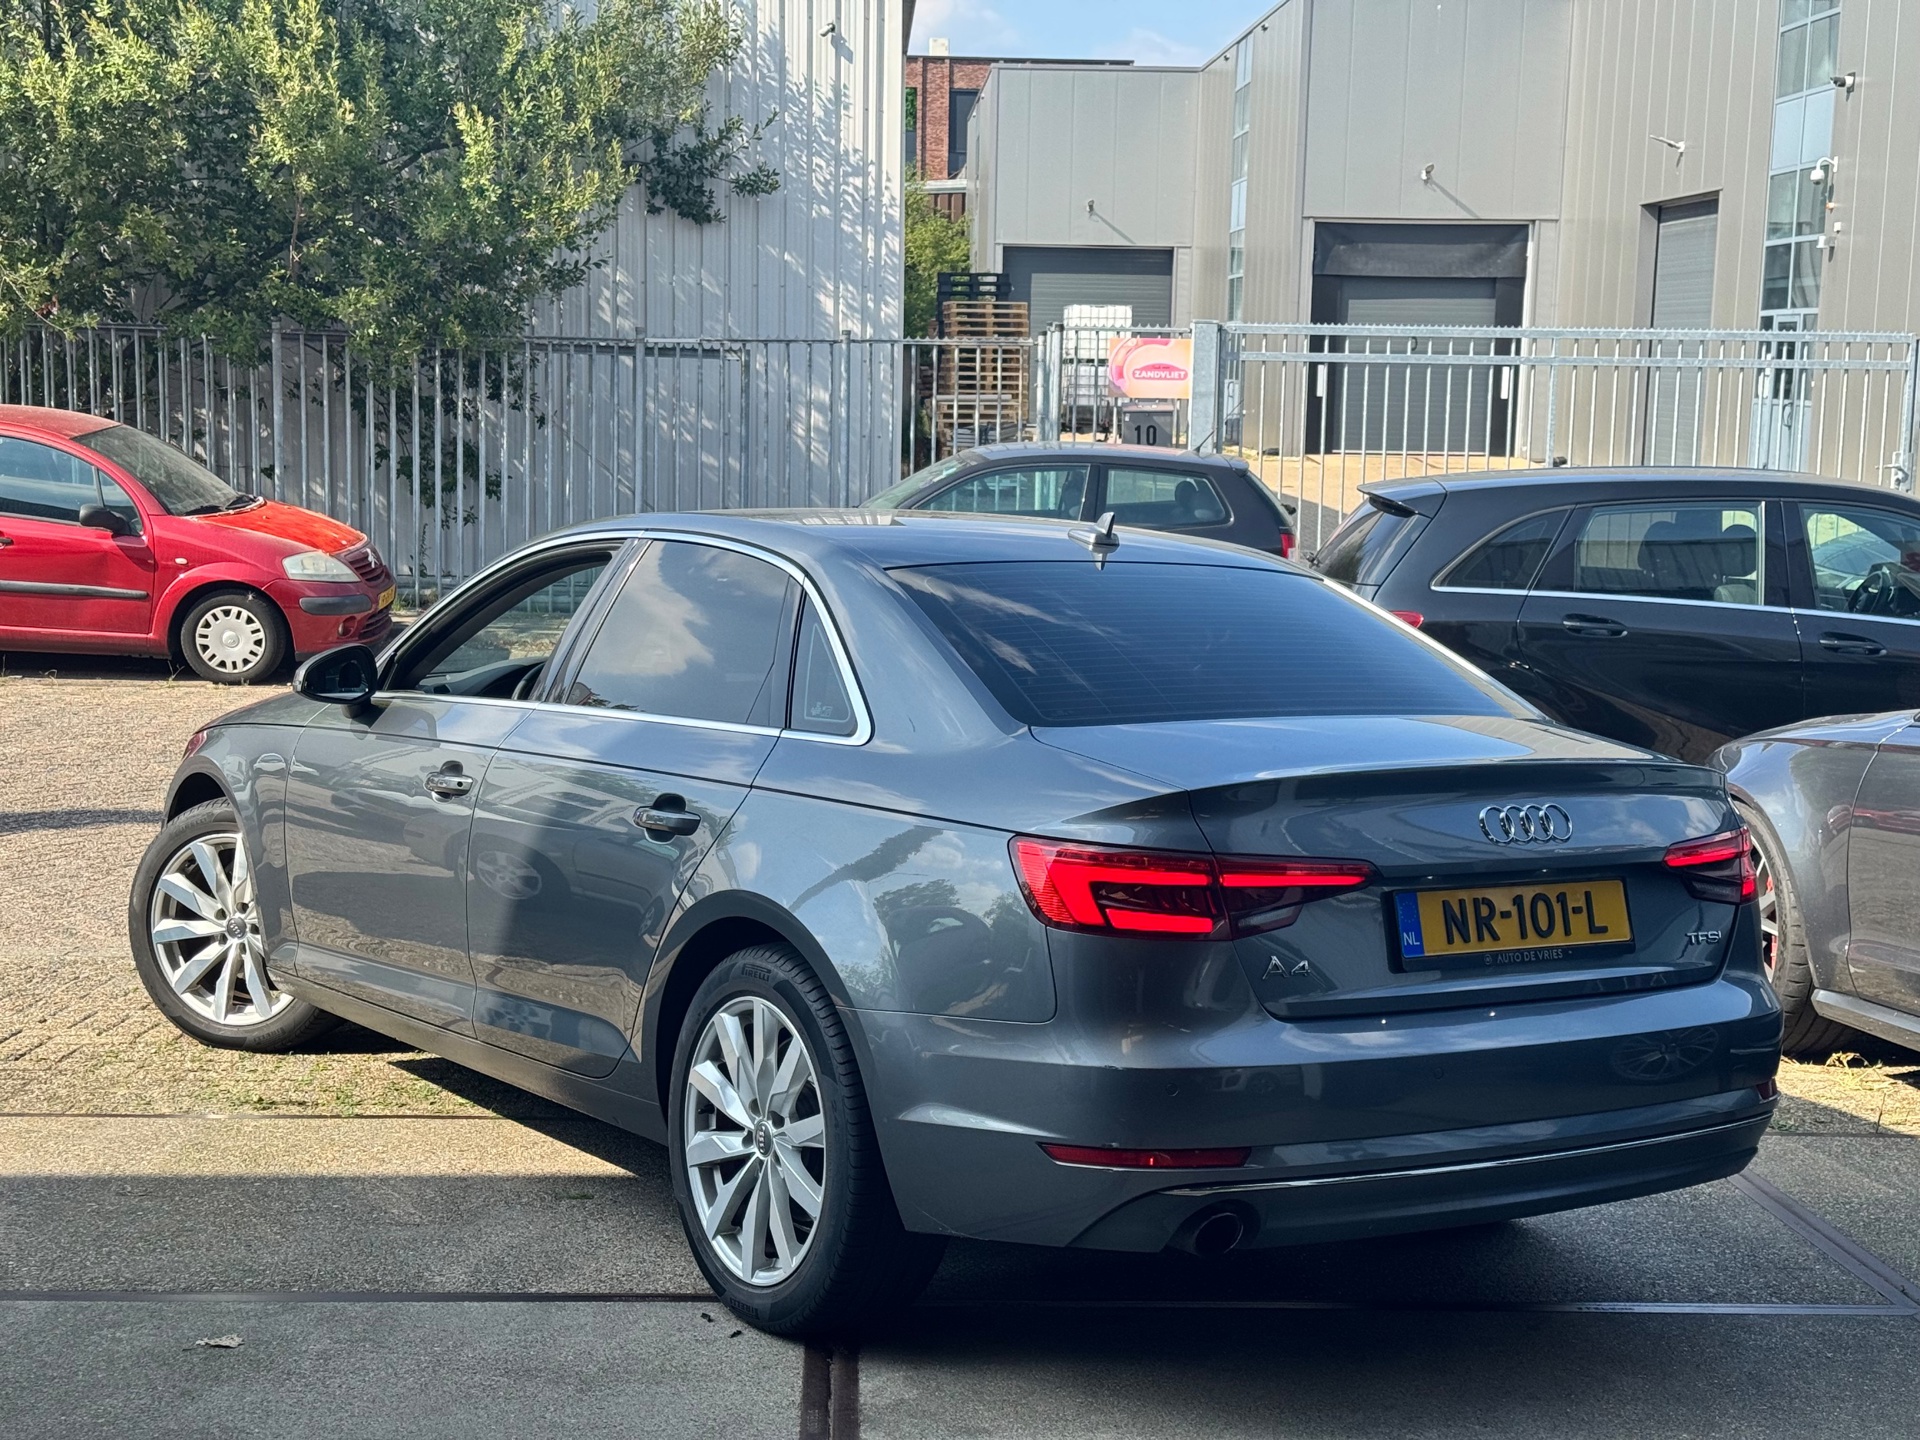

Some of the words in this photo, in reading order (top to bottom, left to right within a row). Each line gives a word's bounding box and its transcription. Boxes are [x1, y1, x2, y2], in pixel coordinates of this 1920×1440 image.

[1134, 425, 1158, 446] 10
[1442, 890, 1609, 945] NR-101-L
[1403, 931, 1420, 946] NL
[1686, 930, 1722, 944] TFSI
[1497, 952, 1522, 964] AUTO
[1524, 951, 1536, 962] DE
[1537, 949, 1563, 961] VRIES
[742, 963, 772, 982] PIRELLI
[1262, 955, 1311, 980] A4
